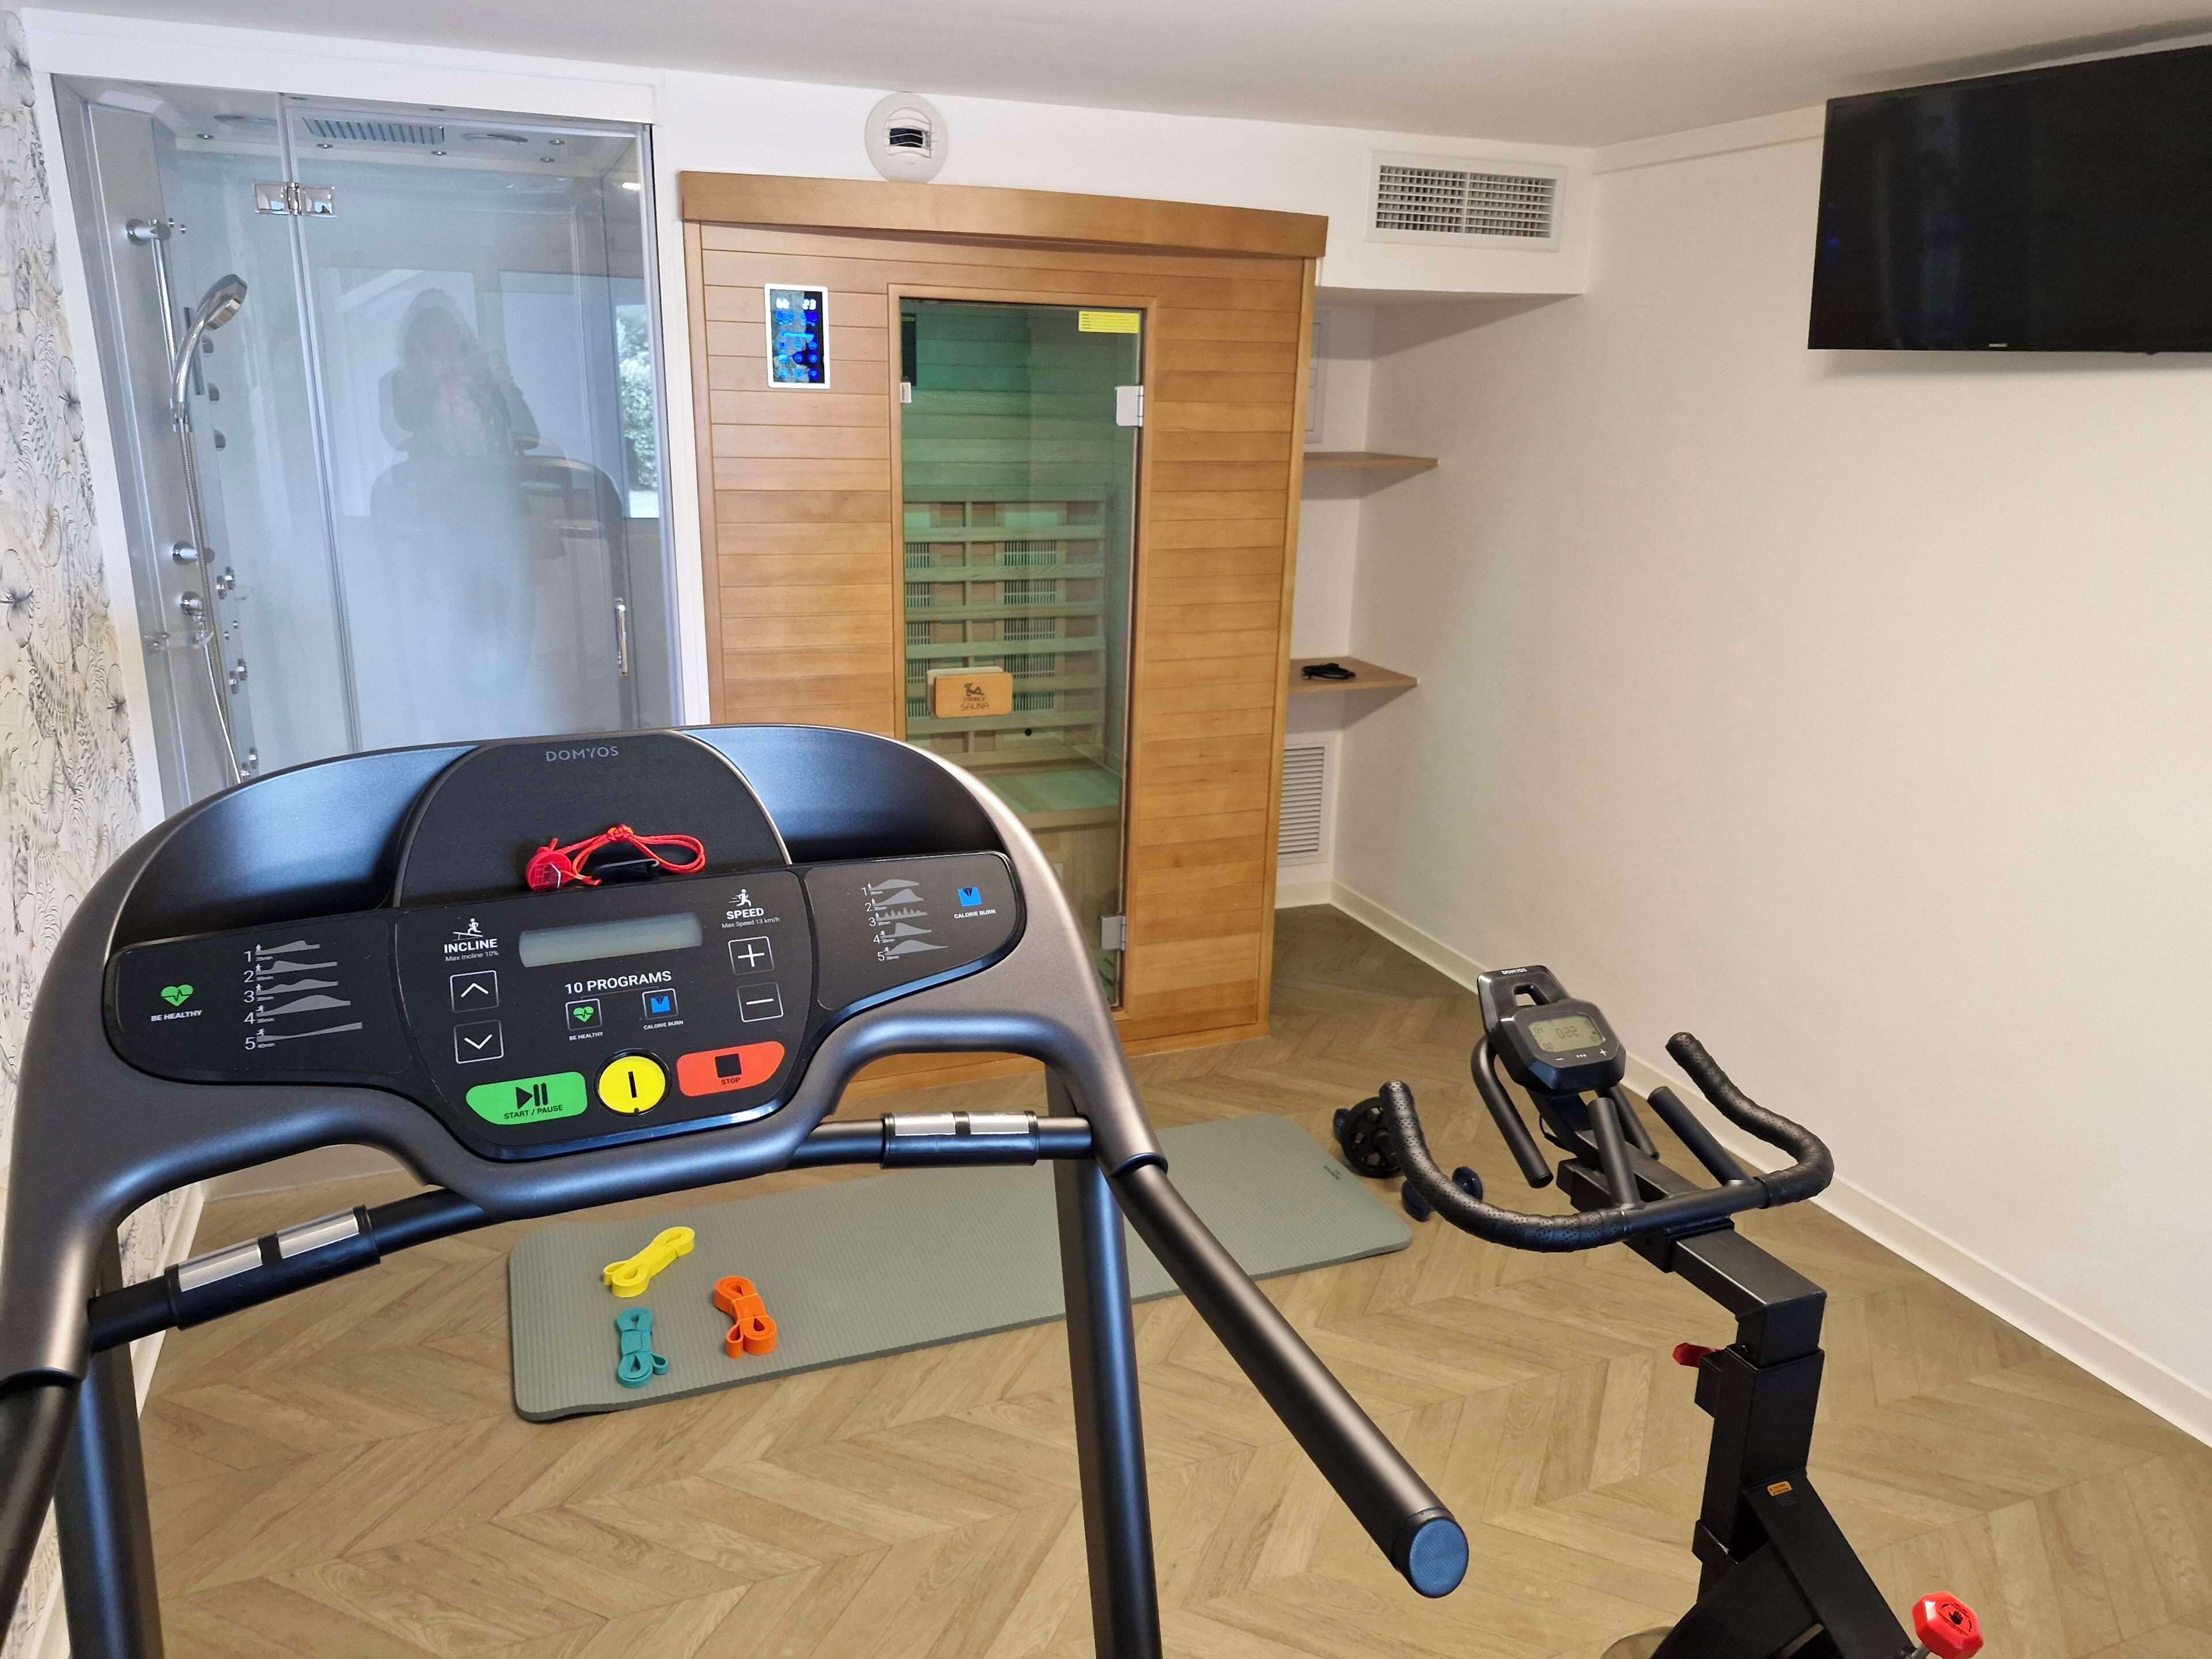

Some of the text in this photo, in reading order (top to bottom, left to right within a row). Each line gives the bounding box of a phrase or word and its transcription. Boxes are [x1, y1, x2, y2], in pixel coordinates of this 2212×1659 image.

[960, 702, 990, 711] SAUNA
[546, 746, 619, 762] DOMYOS
[861, 887, 868, 896] 1
[865, 902, 874, 912] 2
[726, 907, 764, 920] SPEED
[954, 911, 979, 919] CALORIE
[736, 919, 755, 928] Speed
[868, 917, 876, 926] 3
[873, 934, 881, 944] 4
[444, 938, 498, 954] INCLINE
[244, 950, 252, 963] 1
[877, 951, 885, 961] 5
[243, 969, 255, 983] 2
[565, 970, 672, 995] 10 PROGRAMS
[244, 990, 255, 1003] 3
[164, 1010, 203, 1020] HEALTHY
[244, 1012, 256, 1024] 4
[643, 1022, 667, 1030] CALORIE
[578, 1031, 604, 1039] HEALTHY
[244, 1036, 256, 1050] 5
[721, 1076, 741, 1085] STOP
[503, 1109, 529, 1119] START
[537, 1105, 563, 1114] PAUSE
